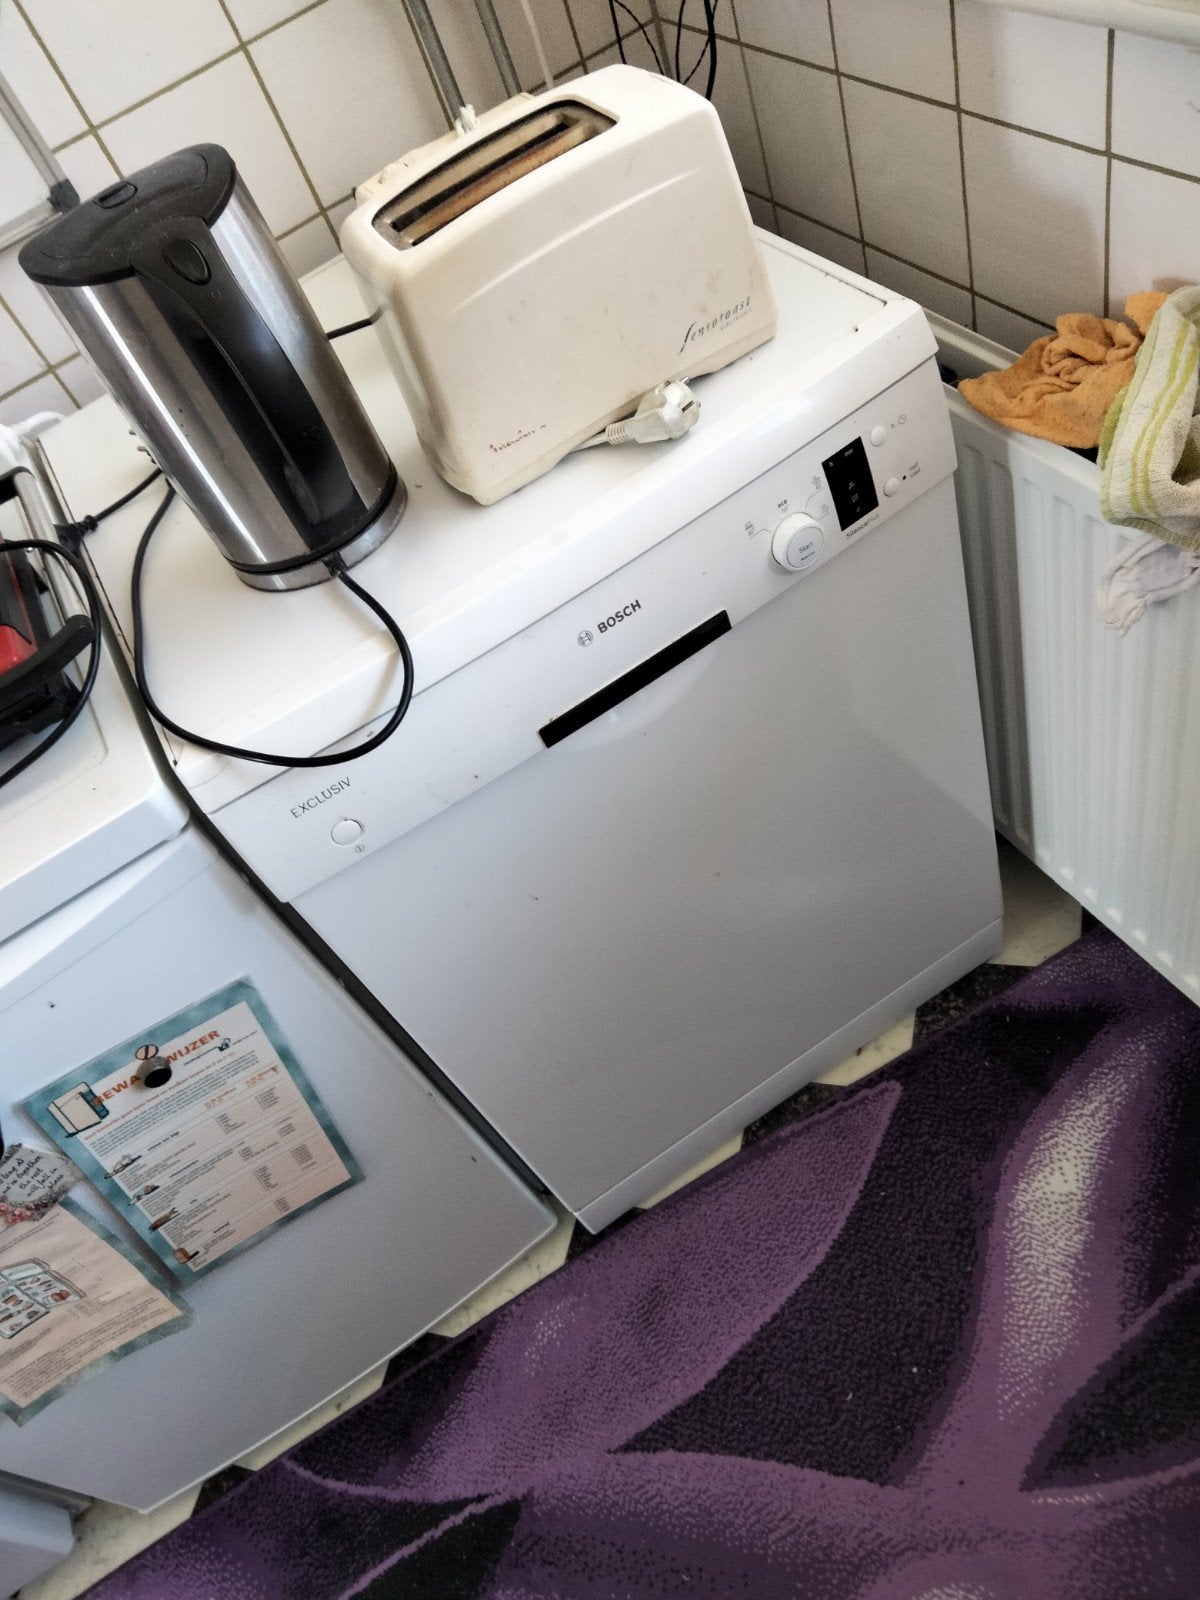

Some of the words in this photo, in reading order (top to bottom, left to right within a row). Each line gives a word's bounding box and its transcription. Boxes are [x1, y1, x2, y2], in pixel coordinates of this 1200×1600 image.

[777, 498, 788, 509] eco
[799, 541, 814, 553] Start
[597, 599, 642, 634] BOSCH
[290, 776, 353, 819] EXCLUSIV
